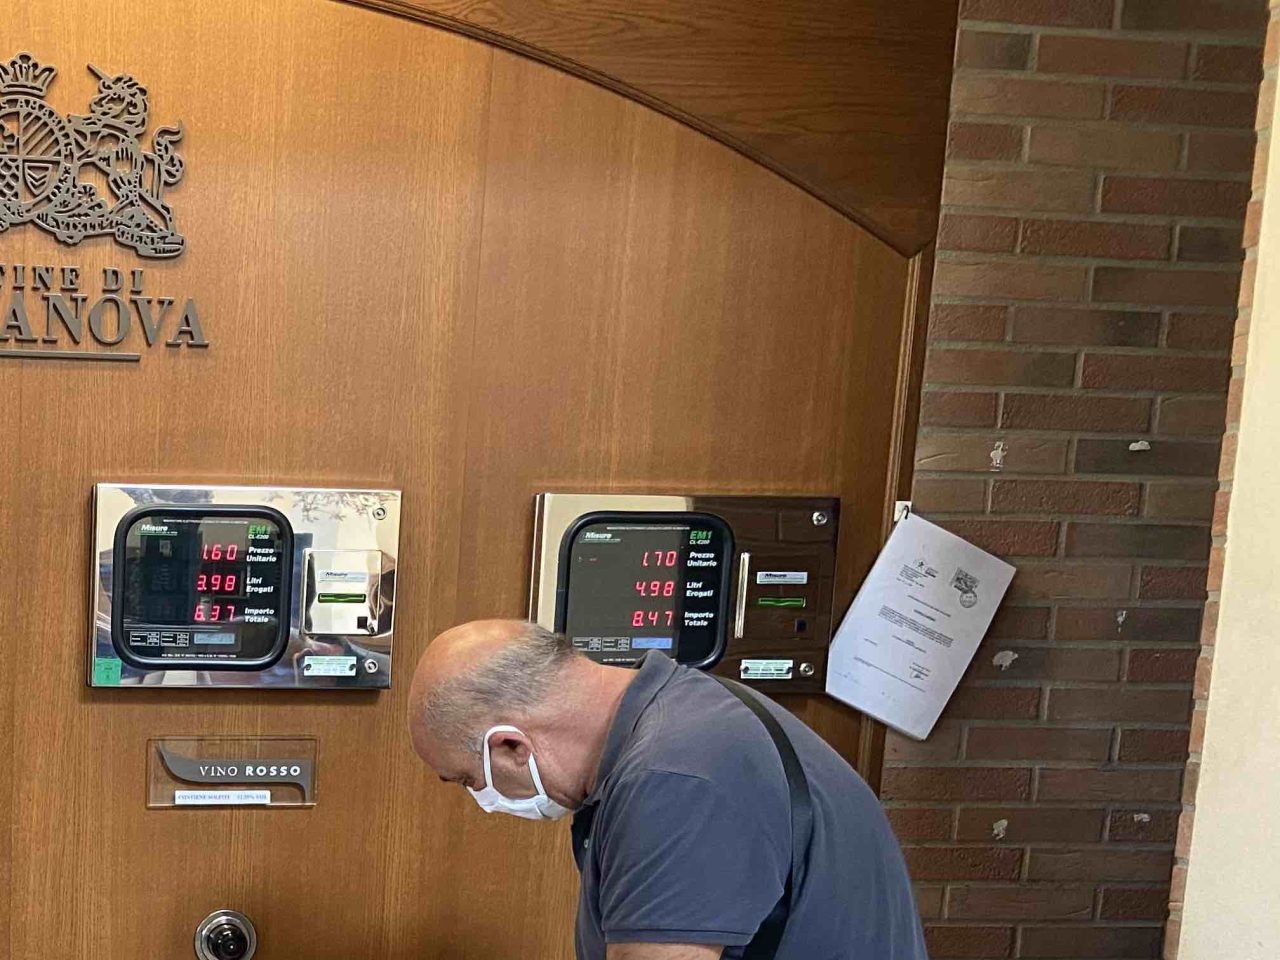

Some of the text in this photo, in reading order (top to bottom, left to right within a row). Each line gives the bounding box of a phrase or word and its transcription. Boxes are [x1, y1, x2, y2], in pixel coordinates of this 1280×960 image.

[103, 267, 144, 294] DI
[249, 526, 271, 534] EM1
[690, 531, 712, 539] EM1
[202, 544, 237, 560] 1.60
[246, 555, 276, 563] Unitario
[642, 551, 677, 566] 1.70
[197, 575, 235, 591] 3.98
[246, 577, 262, 585] Litri
[246, 585, 273, 594] Erogati
[636, 581, 674, 597] 4.98
[686, 582, 703, 590] Litri
[686, 589, 713, 598] Erogati
[194, 605, 235, 621] 6.37
[244, 608, 274, 616] Importo
[684, 612, 714, 620] Importo
[632, 611, 674, 627] 8.47
[684, 619, 708, 627] Totale
[200, 766, 301, 777] VINO ROSSO
